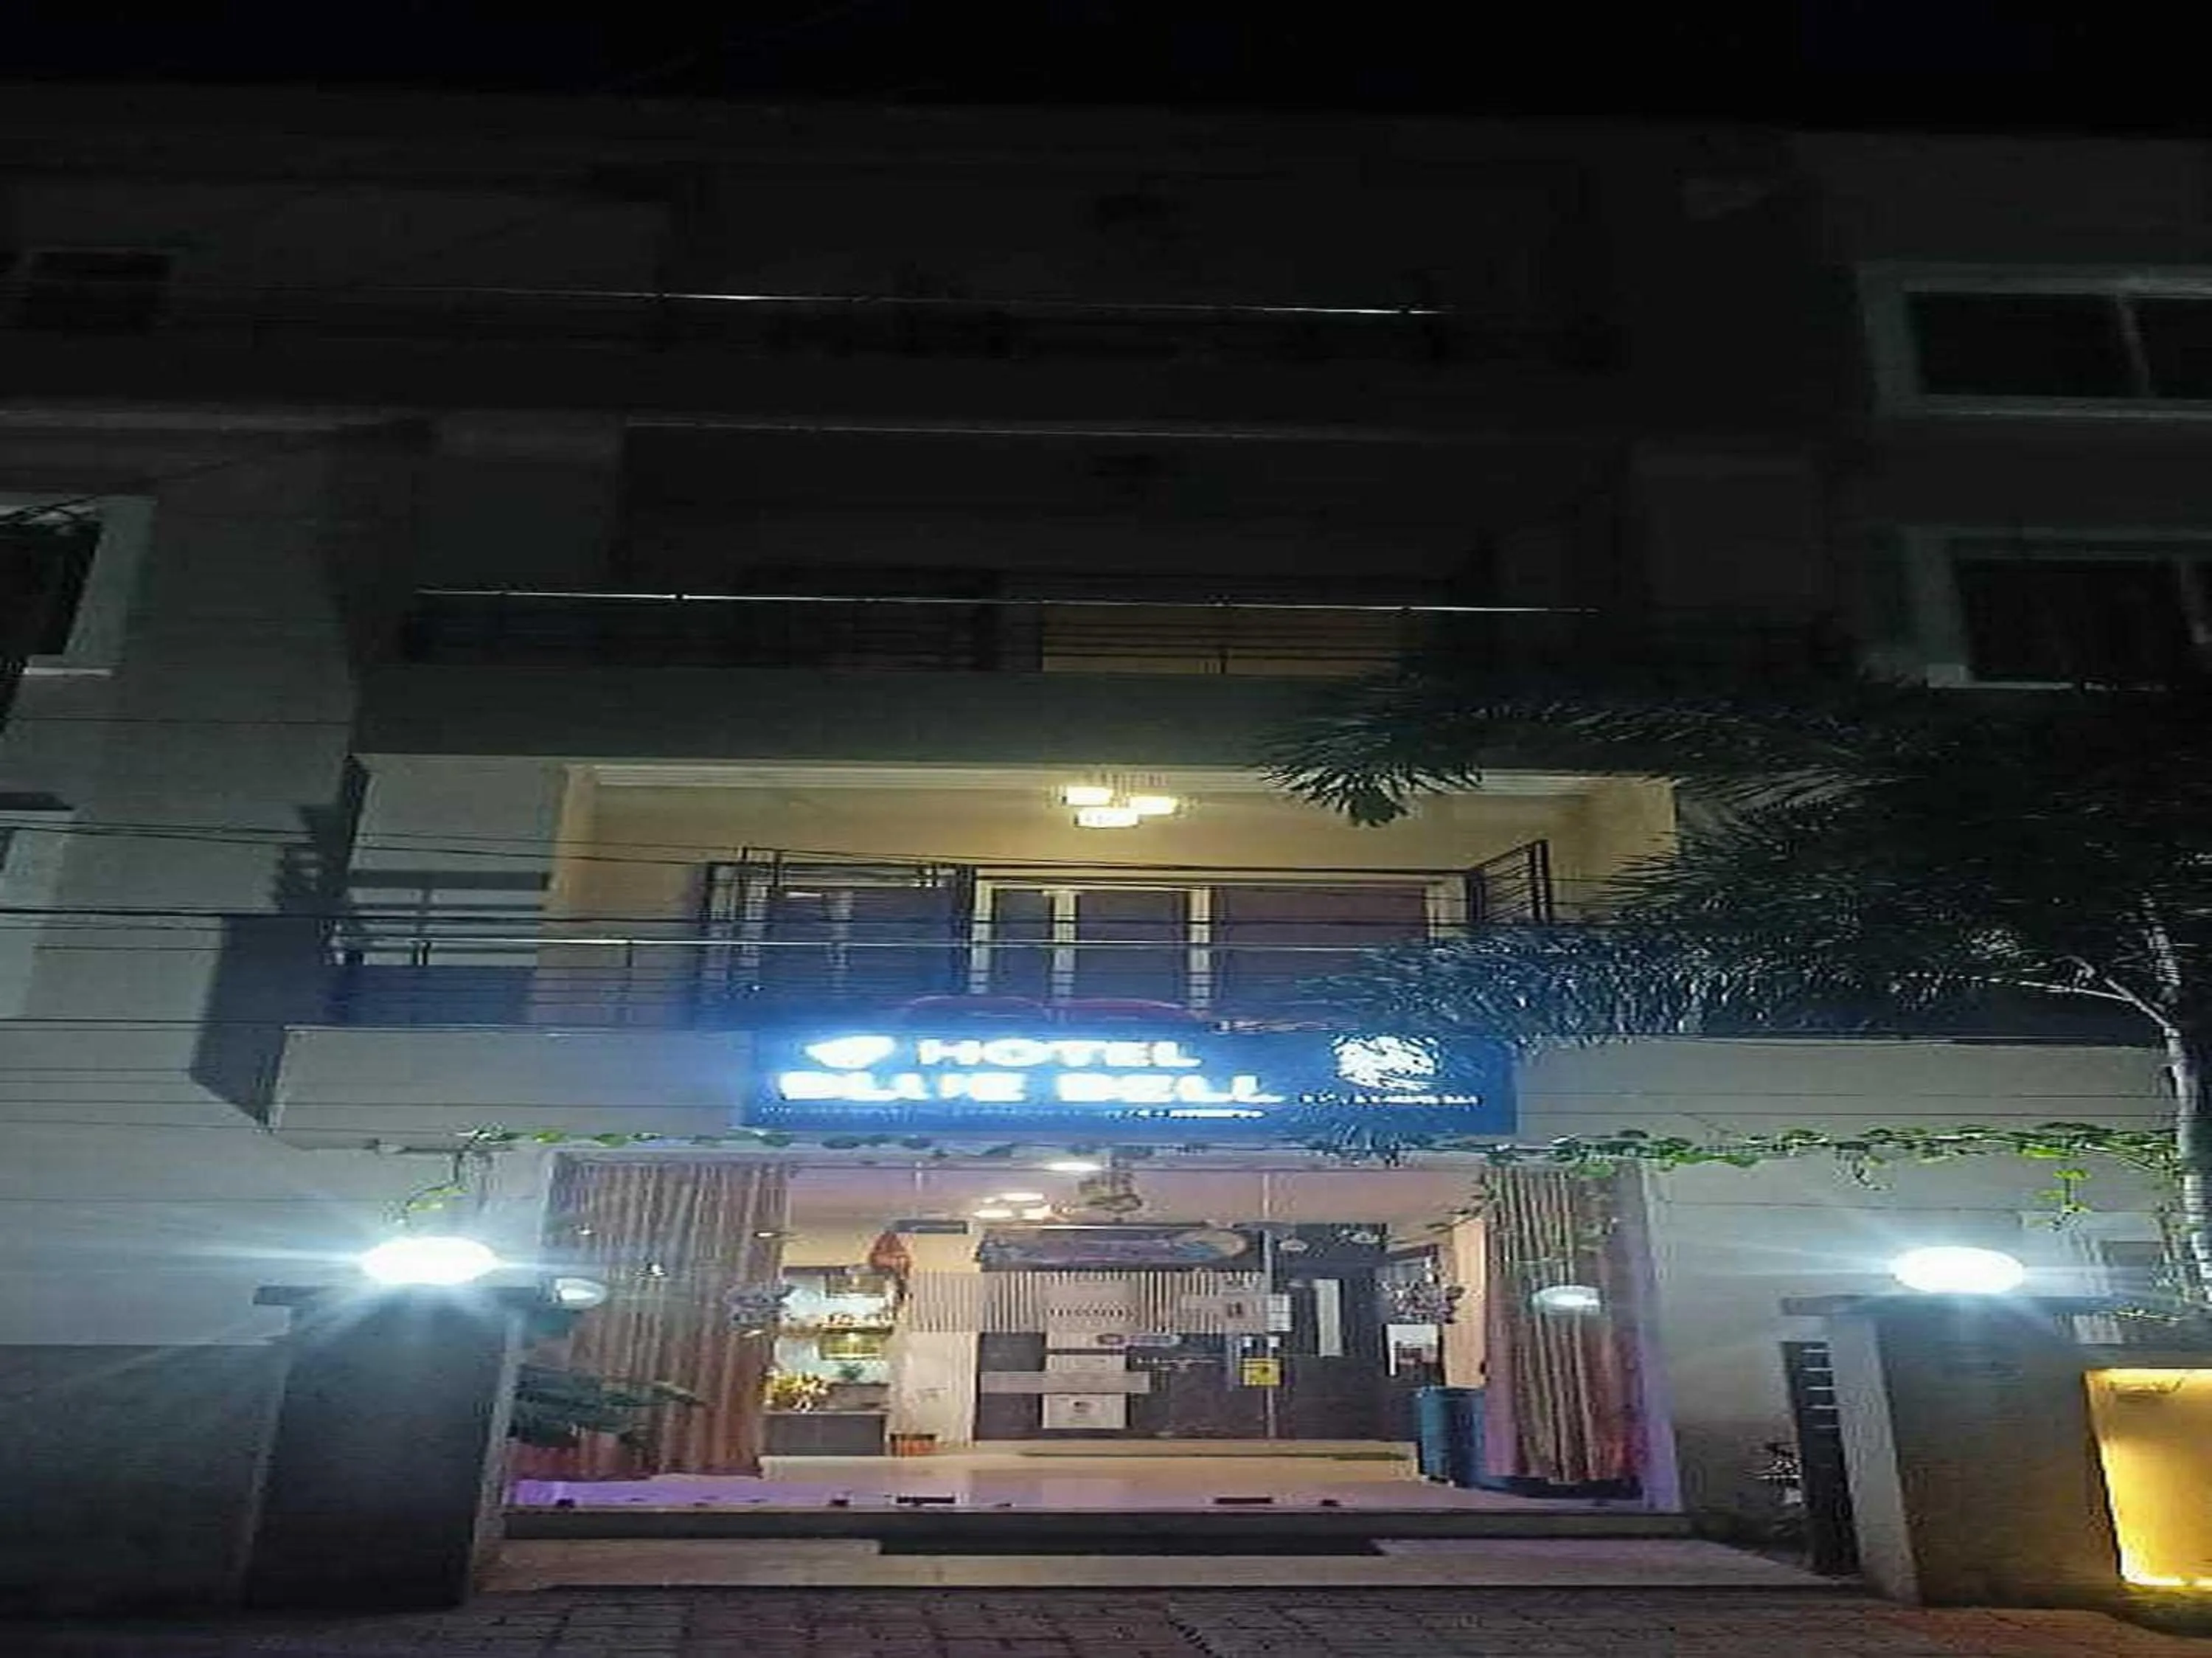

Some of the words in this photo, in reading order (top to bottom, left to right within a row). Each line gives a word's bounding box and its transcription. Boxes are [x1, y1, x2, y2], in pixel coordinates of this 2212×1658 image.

[918, 1039, 1203, 1067] HOTEL
[779, 1071, 1026, 1102] BLUE
[1056, 1072, 1287, 1103] BELL
